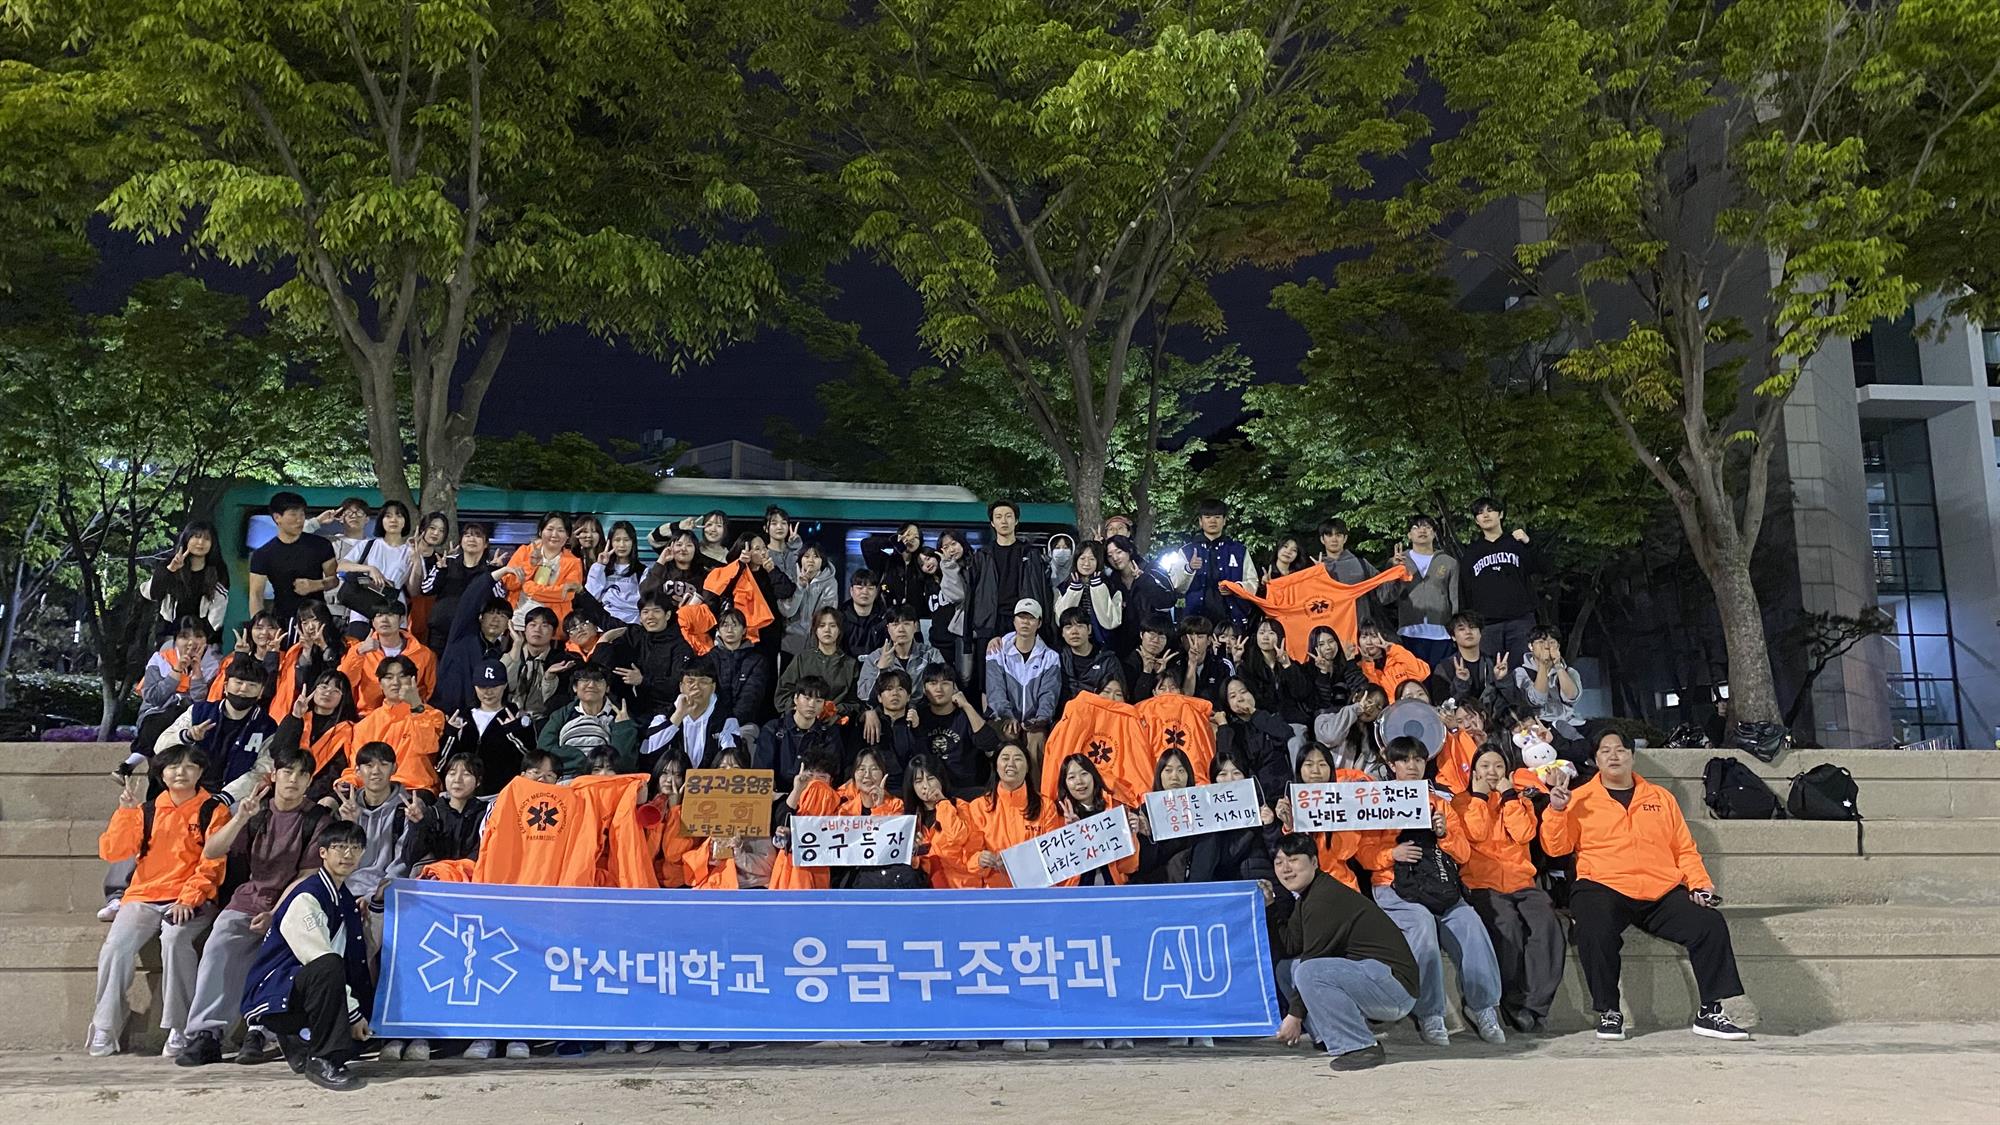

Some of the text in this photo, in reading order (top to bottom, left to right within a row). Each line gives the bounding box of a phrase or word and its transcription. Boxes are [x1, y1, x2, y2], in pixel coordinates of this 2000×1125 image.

[1228, 553, 1239, 568] A
[484, 667, 495, 680] R
[243, 732, 264, 754] A
[1212, 790, 1239, 804] 져도
[1297, 789, 1343, 809] 응구과
[1214, 809, 1257, 823] 지지마
[1642, 803, 1662, 812] EMT
[1308, 809, 1348, 827] 난리도
[1039, 828, 1076, 857] 우리는
[1047, 850, 1081, 875] 너희는
[544, 935, 1122, 1004] 안산대학교 응급구조학과
[1142, 922, 1232, 1002] AU
